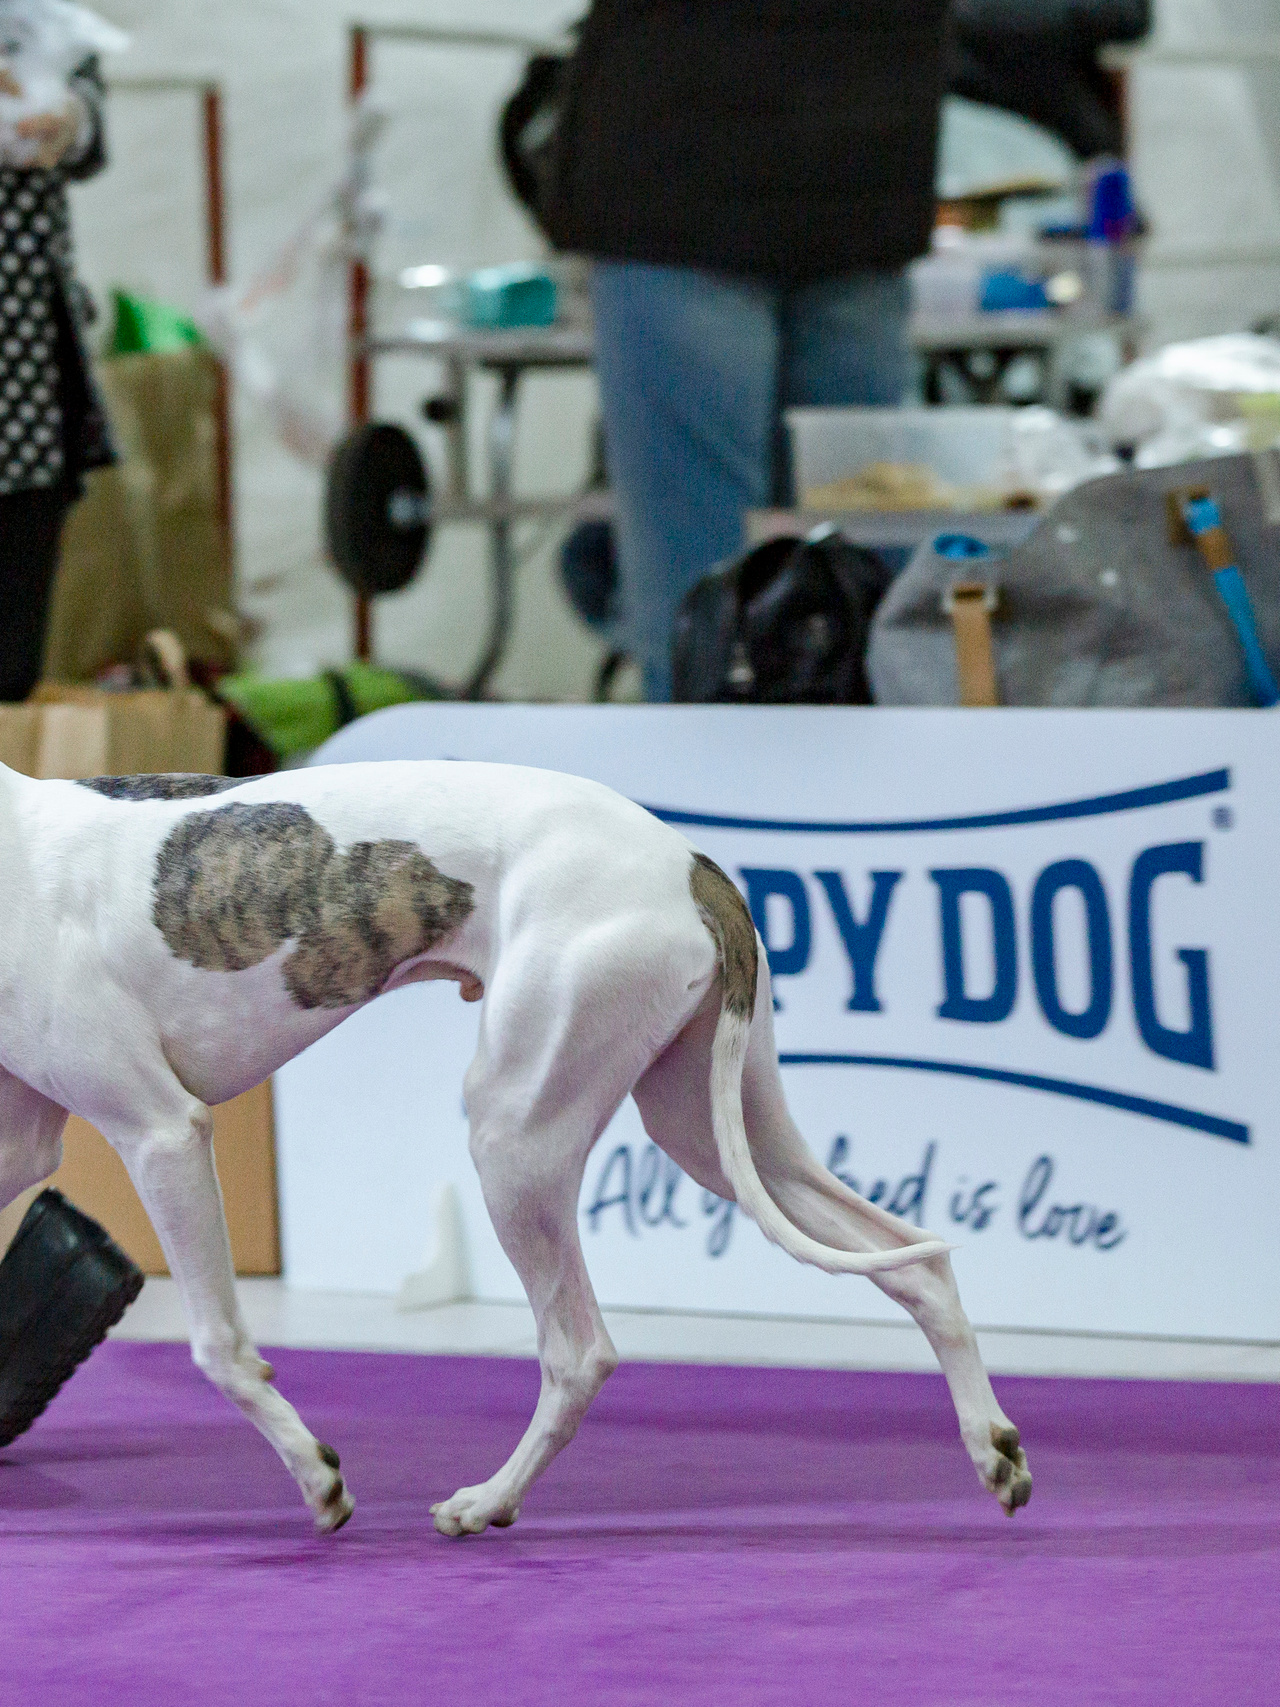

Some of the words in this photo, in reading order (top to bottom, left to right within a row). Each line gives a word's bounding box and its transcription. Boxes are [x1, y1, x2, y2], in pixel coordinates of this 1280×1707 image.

[738, 867, 906, 1013] PY
[927, 840, 1218, 1073] DOG
[586, 1143, 689, 1240] All
[949, 1175, 1001, 1232] is
[1018, 1154, 1128, 1251] love
